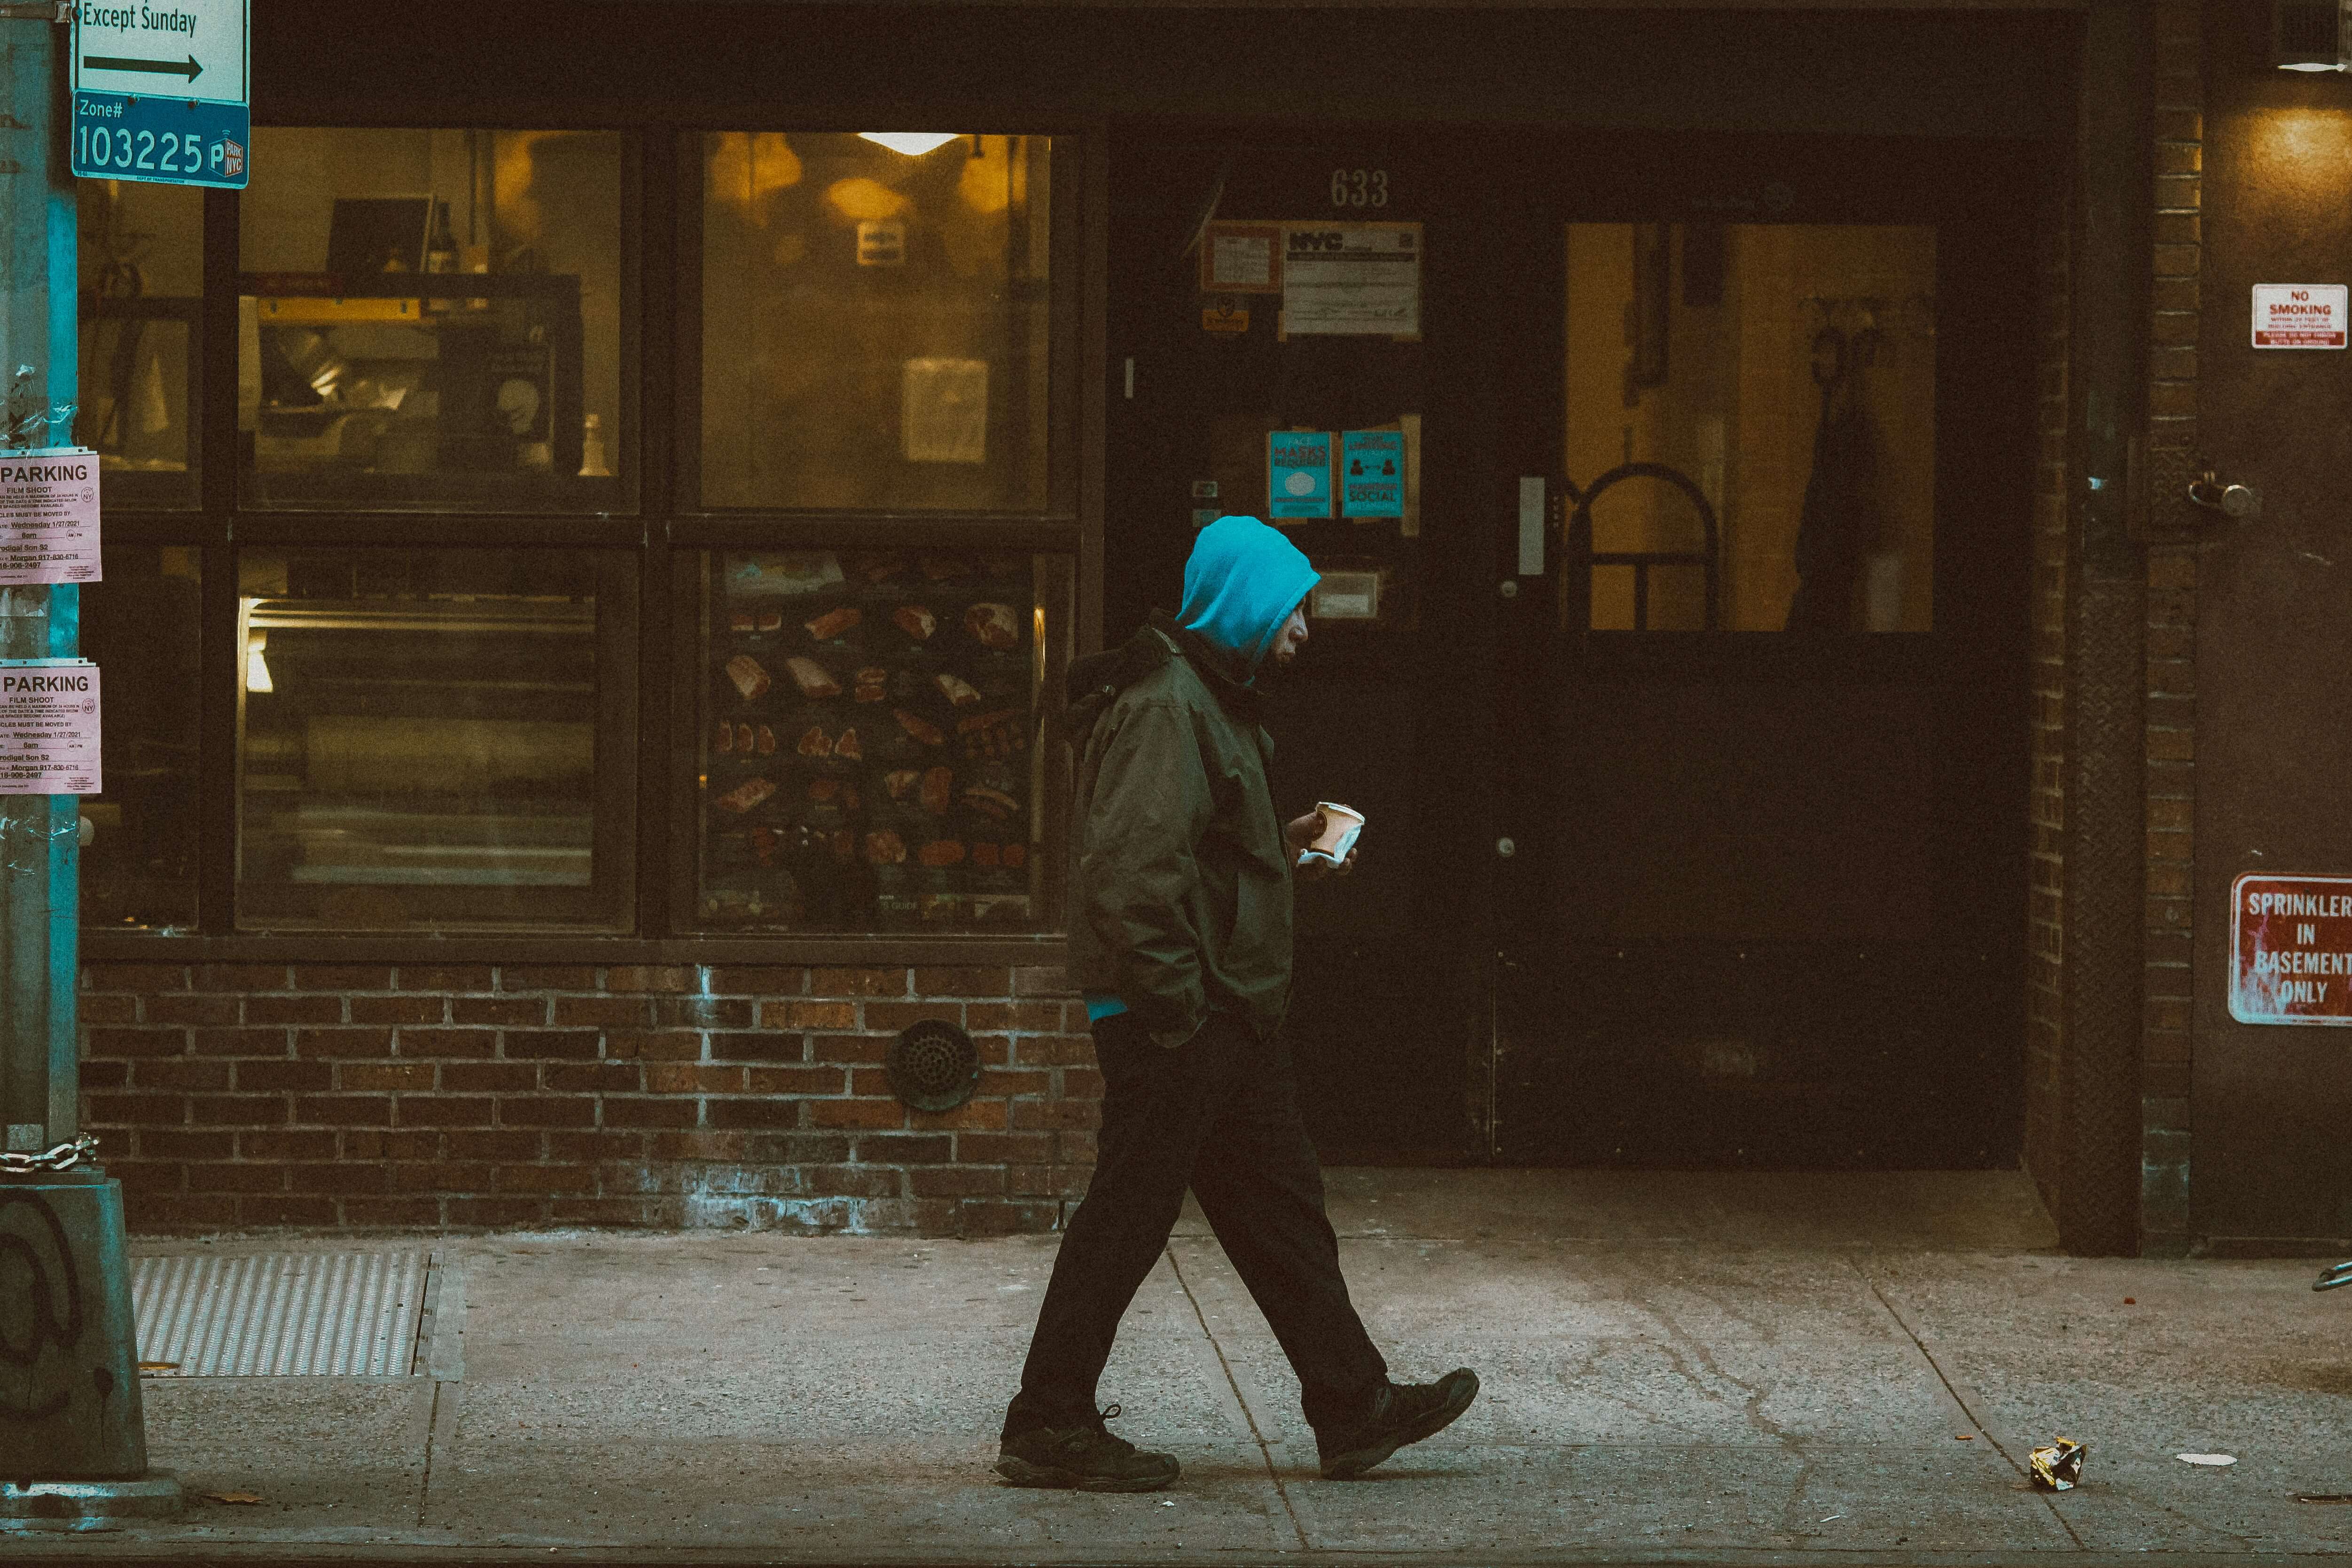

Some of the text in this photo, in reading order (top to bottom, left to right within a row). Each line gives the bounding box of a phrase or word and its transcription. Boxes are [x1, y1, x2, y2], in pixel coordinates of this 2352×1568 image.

[83, 3, 196, 38] Except Sunday
[80, 99, 122, 118] Zone#
[80, 125, 224, 173] 103225 P
[227, 141, 241, 157] PARK
[227, 157, 242, 174] NYC
[1331, 169, 1388, 207] 633
[1289, 232, 1343, 250] NYC
[2291, 291, 2309, 301] NO
[2270, 304, 2331, 315] SMOKING
[1288, 436, 1311, 445] FACE
[1274, 446, 1326, 458] MASKS
[0, 465, 87, 483] PARKING
[1349, 490, 1396, 502] SOCIAL
[3, 676, 88, 692] PARKING
[2248, 892, 2352, 917] SPRINKLER
[2297, 924, 2316, 945] IN
[2255, 951, 2352, 975] BASEMENT
[2280, 980, 2328, 1003] ONLY
